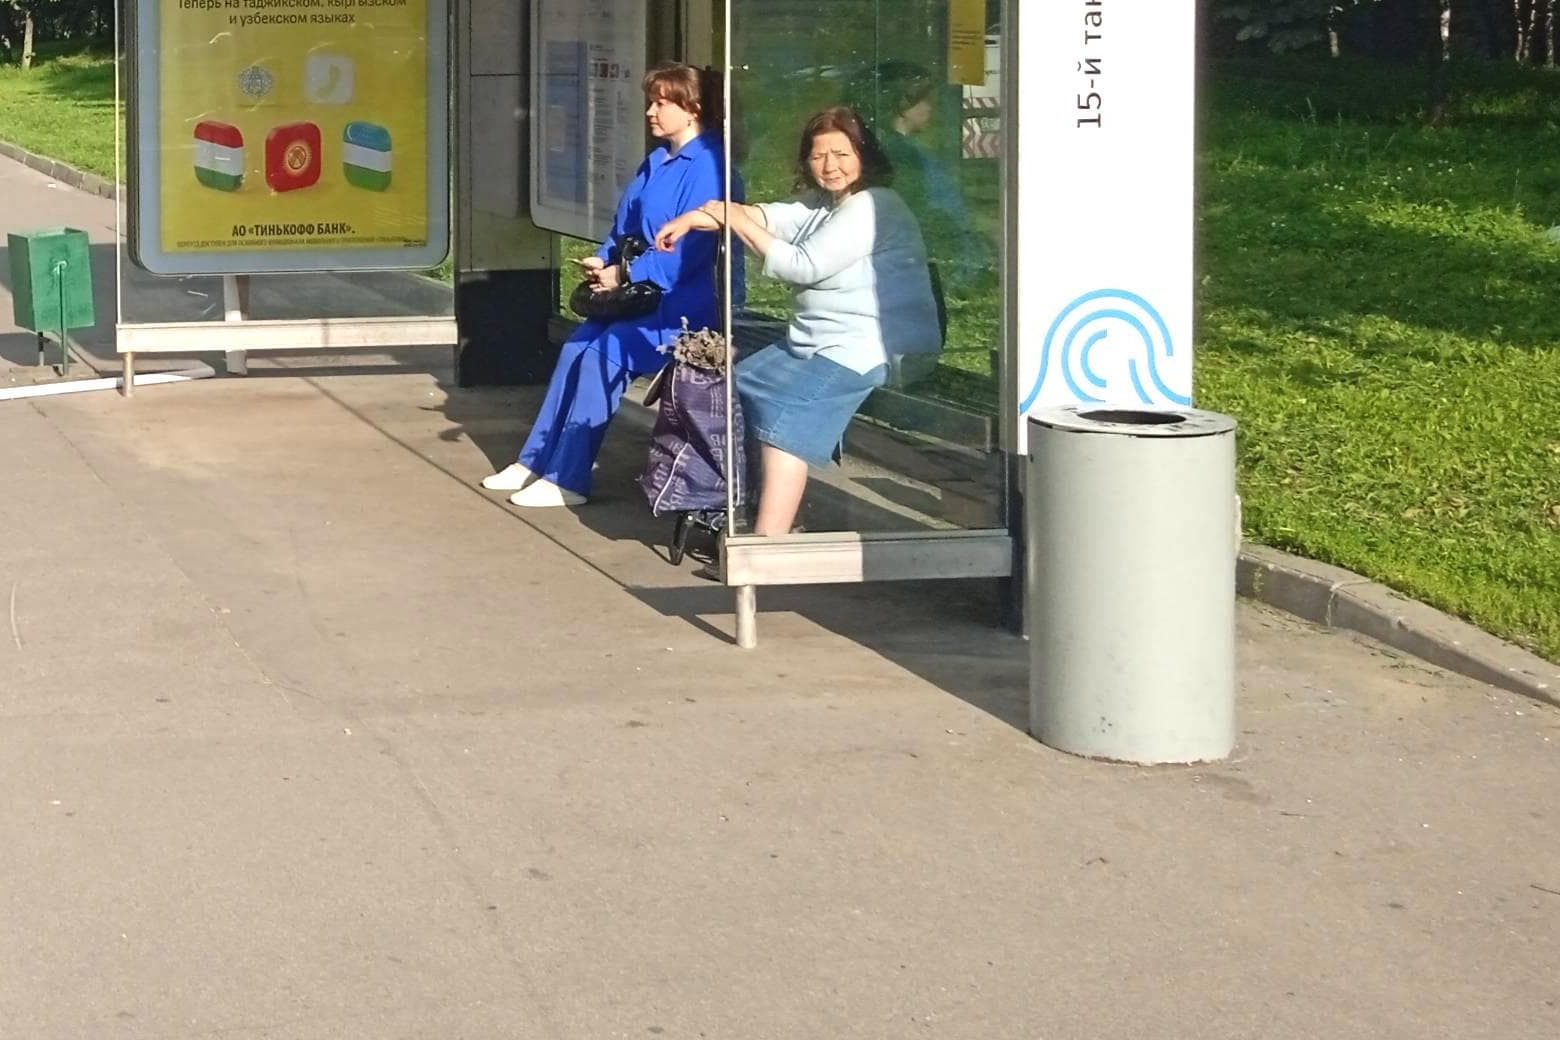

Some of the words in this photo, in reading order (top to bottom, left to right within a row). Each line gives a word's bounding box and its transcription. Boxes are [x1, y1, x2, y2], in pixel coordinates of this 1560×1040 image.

[228, 13, 238, 25] и
[239, 11, 308, 27] узбекском
[309, 11, 356, 25] языках
[1076, 58, 1102, 129] 15-й
[231, 224, 247, 238] АО
[248, 223, 316, 237] «ТИНЬКОФФ
[316, 222, 356, 236] БАНК».
